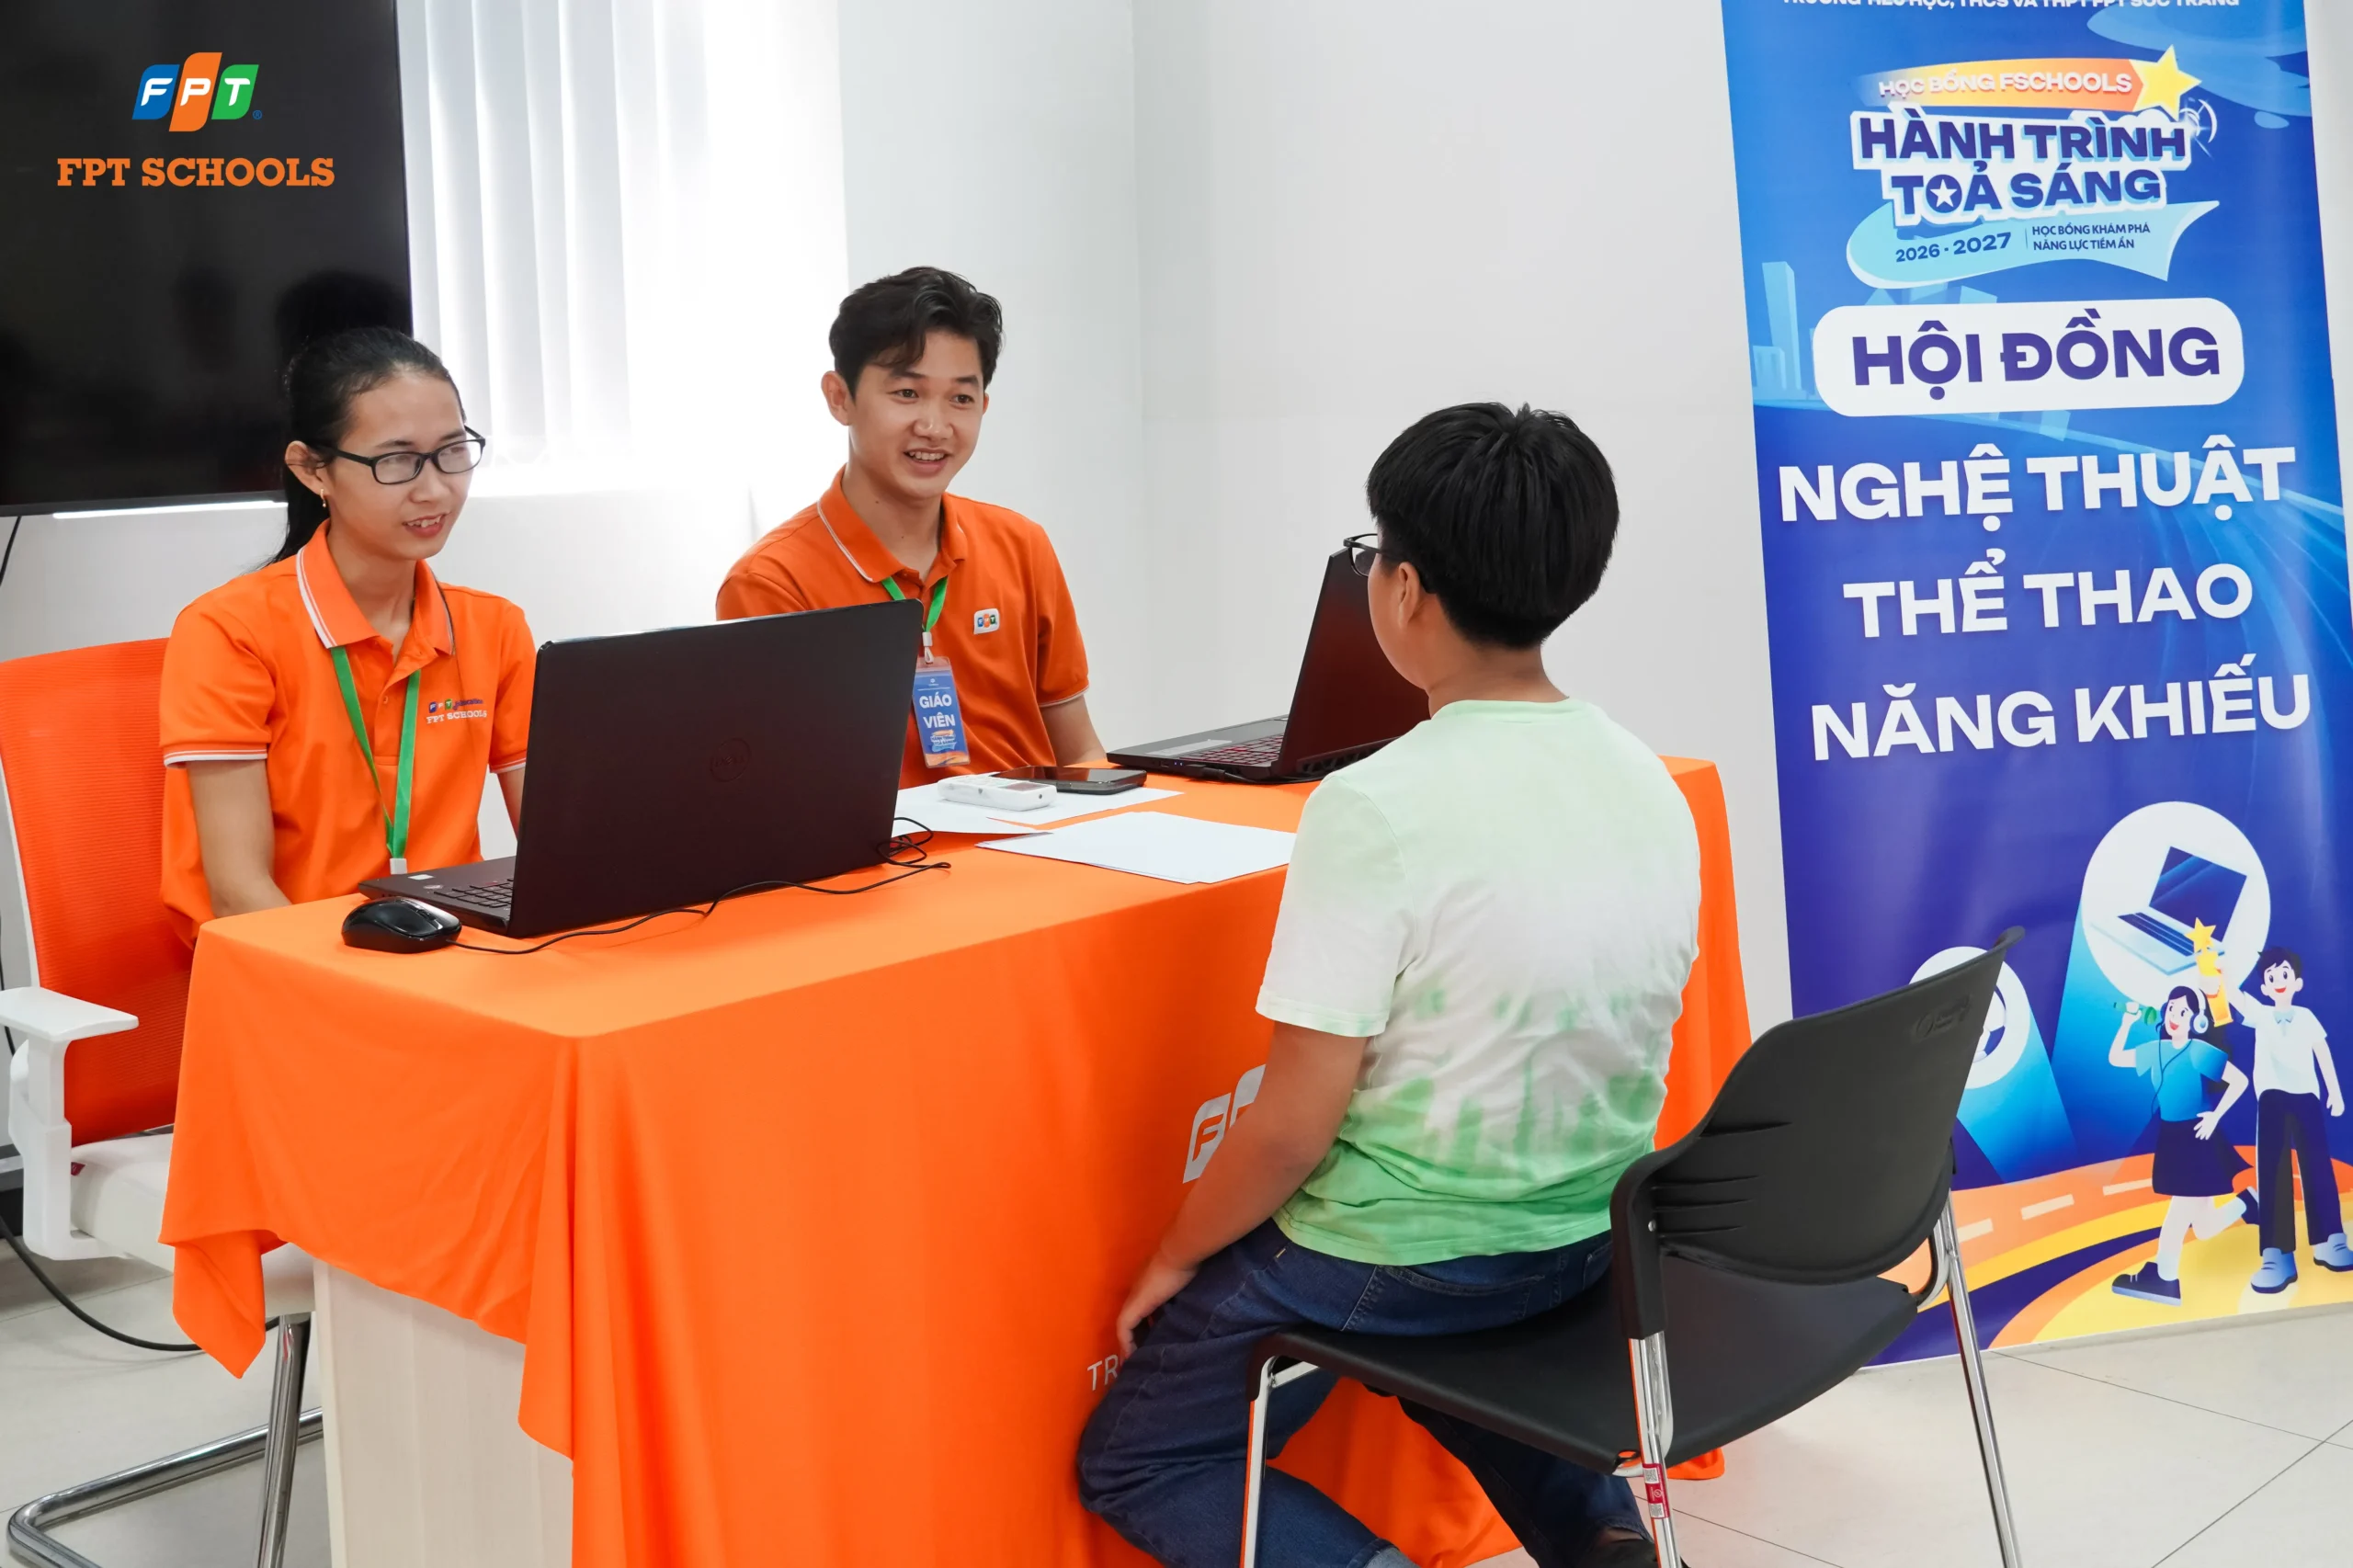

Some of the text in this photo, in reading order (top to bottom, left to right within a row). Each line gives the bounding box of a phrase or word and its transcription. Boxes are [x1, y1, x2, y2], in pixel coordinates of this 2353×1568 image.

[1879, 78, 1925, 98] HỌC
[2000, 72, 2132, 92] FSCHOOLS
[1859, 108, 2186, 159] HÀNH TRÌNH
[1892, 160, 2161, 215] TOẢ SÁNG
[2032, 226, 2056, 237] HỌC
[2092, 223, 2126, 233] KHÁM
[2128, 222, 2151, 233] PHÁ
[2033, 239, 2067, 250] NĂNG
[2069, 238, 2088, 251] LỰC
[1895, 244, 1940, 262] 2026
[1953, 232, 2011, 255] 2027
[1852, 308, 2220, 401] HỘI ĐỒNG
[1779, 435, 2296, 531] NGHỆ THUẬT
[1843, 549, 2253, 638] THỂ THAO
[919, 691, 952, 709] GIÁO
[1812, 653, 2312, 761] NĂNG KHIẾU
[426, 710, 487, 724] FPT SCHOOLS
[923, 712, 956, 729] VIÊN
[1087, 1355, 1119, 1391] TR
